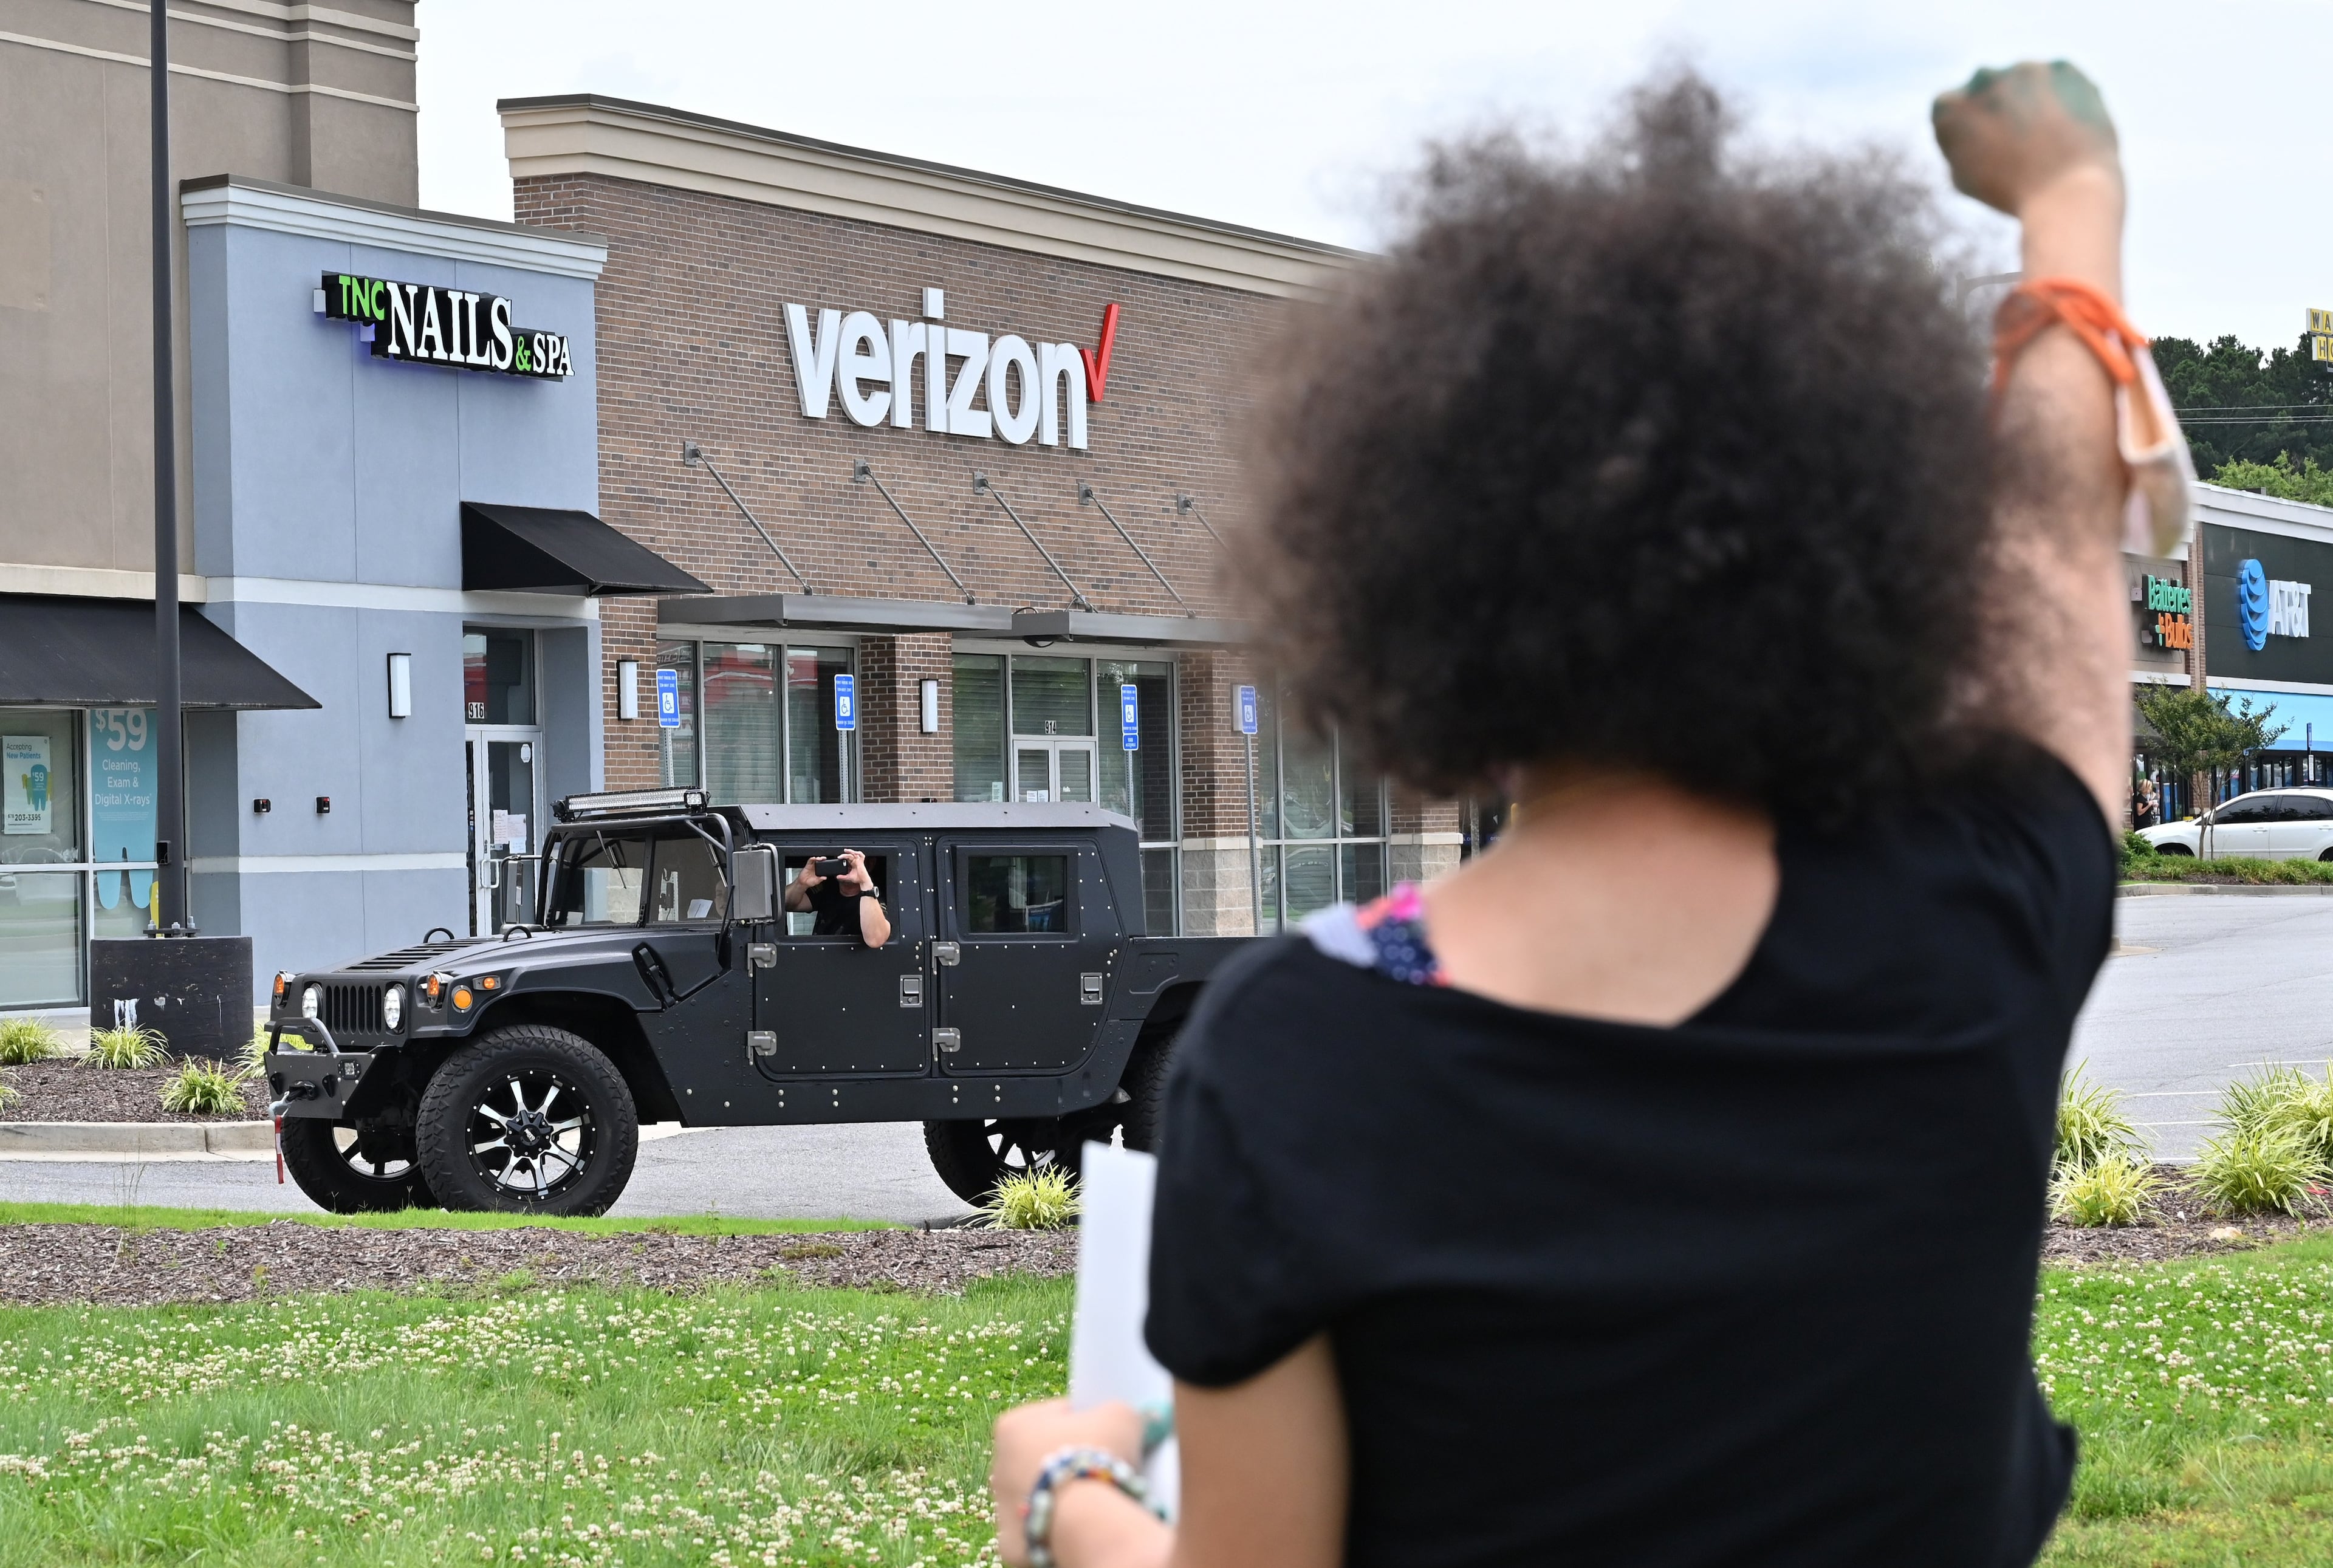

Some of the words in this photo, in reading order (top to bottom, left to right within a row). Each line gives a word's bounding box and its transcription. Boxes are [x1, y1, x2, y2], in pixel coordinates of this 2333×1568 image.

[338, 275, 385, 320] TNC
[386, 281, 513, 370] NAILS
[515, 336, 531, 371] &
[533, 332, 575, 376] SPA
[782, 287, 1088, 450] verizon
[2148, 575, 2191, 614] Batteries
[2269, 580, 2312, 638] AT&T
[469, 703, 484, 718] 916
[95, 710, 148, 751] $59
[1046, 721, 1056, 733] 914
[6, 743, 32, 751] Accepting
[102, 759, 140, 773] Cleaning,
[108, 776, 130, 788] Exam
[132, 776, 139, 788] &
[95, 793, 122, 807] Digital
